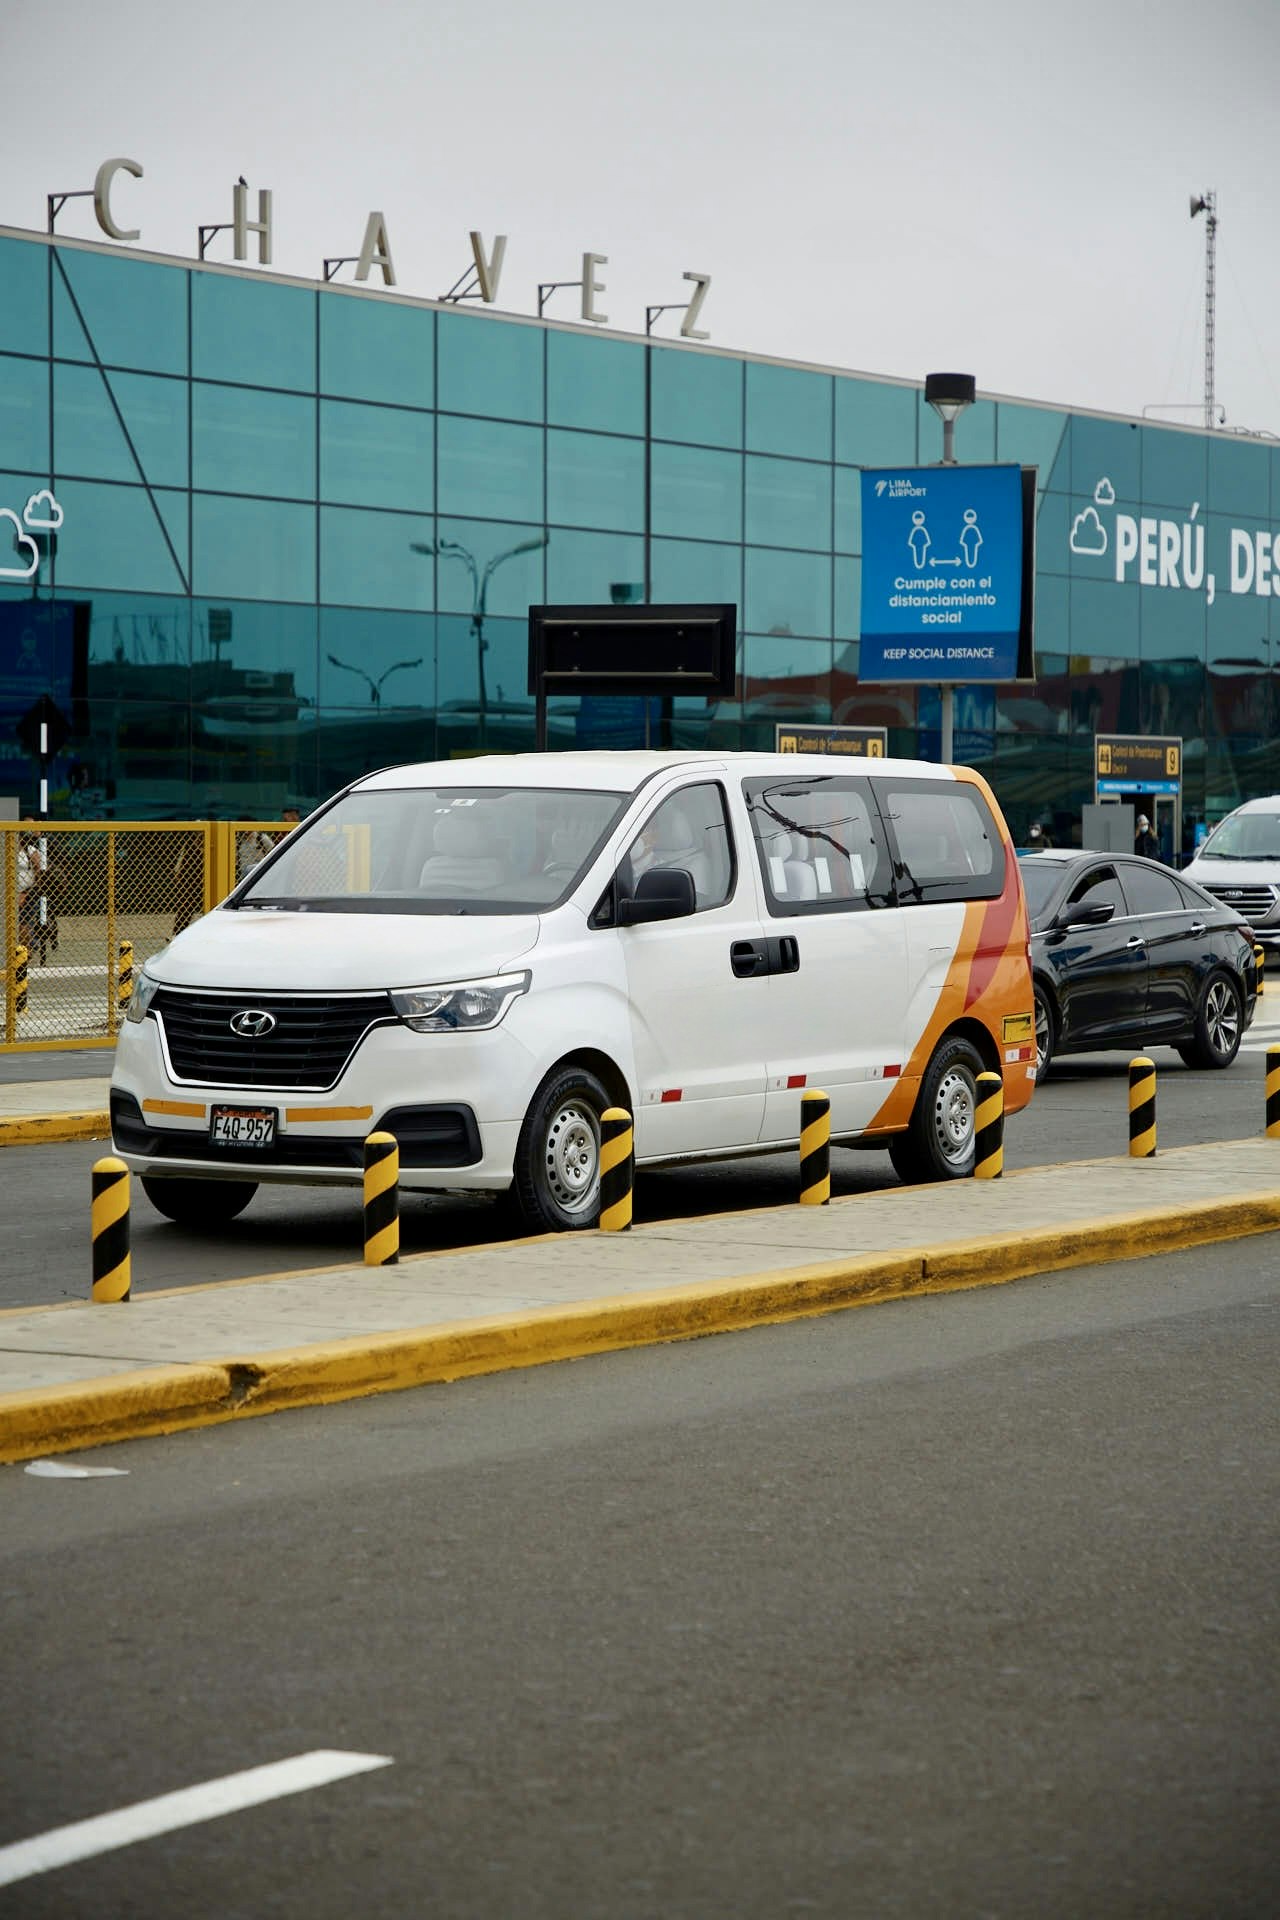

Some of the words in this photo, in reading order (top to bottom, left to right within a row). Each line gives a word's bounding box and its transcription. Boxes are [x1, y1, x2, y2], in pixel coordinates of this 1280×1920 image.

[94, 157, 711, 339] CHAVEZ
[889, 479, 912, 488] LIMA
[889, 487, 927, 497] AIRPORT
[1116, 502, 1215, 605] PERÚ,
[894, 576, 946, 591] Cumple
[950, 578, 975, 589] con
[979, 576, 992, 588] el
[889, 594, 996, 607] distanciamiento
[922, 611, 962, 624] social
[884, 648, 907, 659] KEEP
[909, 648, 945, 659] SOCIAL
[947, 647, 995, 659] DISTANCE
[1170, 751, 1176, 771] 9
[213, 1116, 273, 1141] F4Q-957
